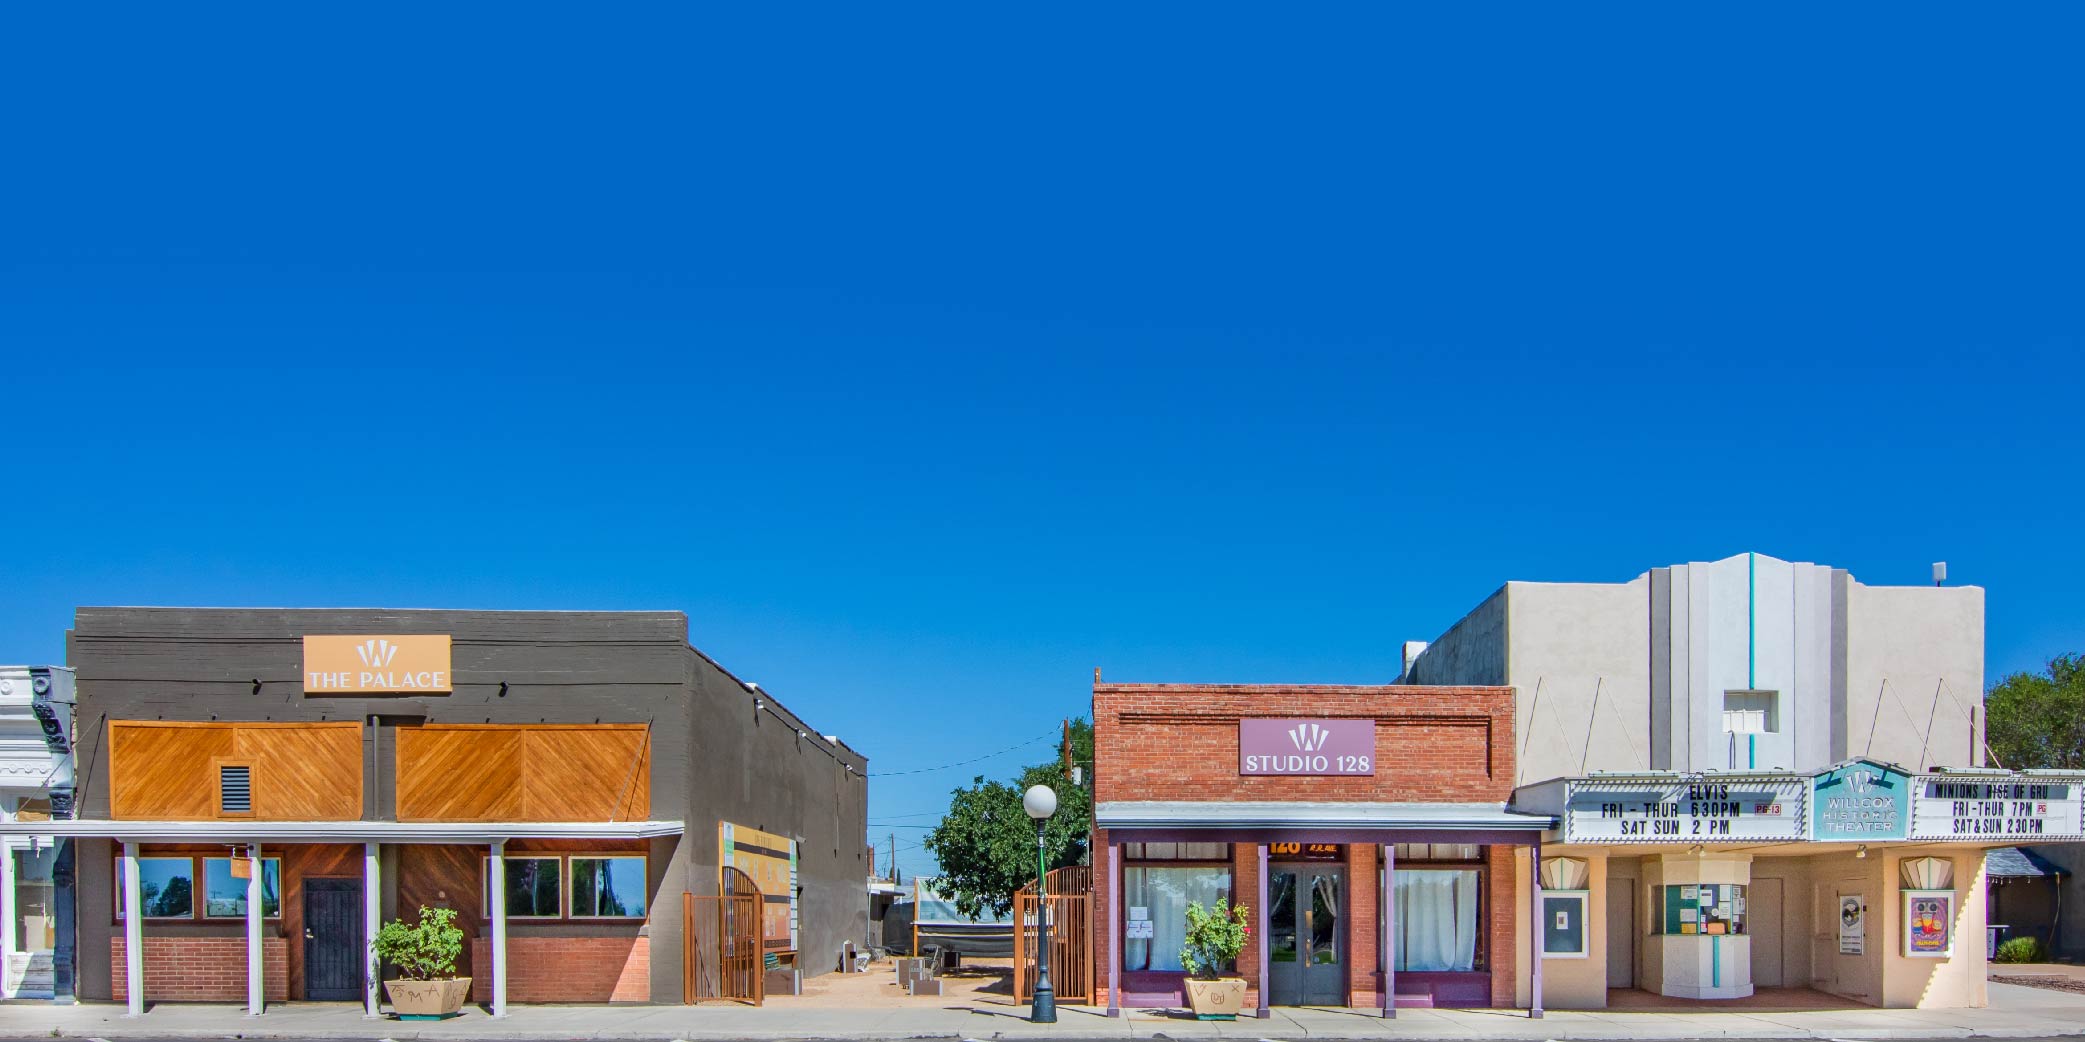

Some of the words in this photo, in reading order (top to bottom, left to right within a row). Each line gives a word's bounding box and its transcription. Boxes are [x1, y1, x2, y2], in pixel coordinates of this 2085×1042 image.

[308, 671, 353, 689] THE
[360, 671, 445, 689] PALACE
[1246, 755, 1329, 772] STUDIO
[1336, 755, 1370, 772] 128
[1689, 784, 1728, 801] ELVIS
[1935, 784, 1978, 799] MINIONS
[1986, 784, 2009, 799] RISE
[2014, 784, 2024, 799] OF
[2030, 784, 2048, 799] GRU
[1601, 803, 1623, 818] FRI
[1643, 802, 1679, 818] THUR
[1756, 805, 1780, 815] PG-13
[1828, 797, 1895, 809] WILLCOX
[1823, 811, 1897, 820] HISTORIC
[1621, 820, 1647, 835] SAT
[1654, 820, 1680, 835] SUN
[1692, 820, 1700, 835] 2
[1709, 820, 1730, 835] PM
[1826, 821, 1893, 832] THEATER
